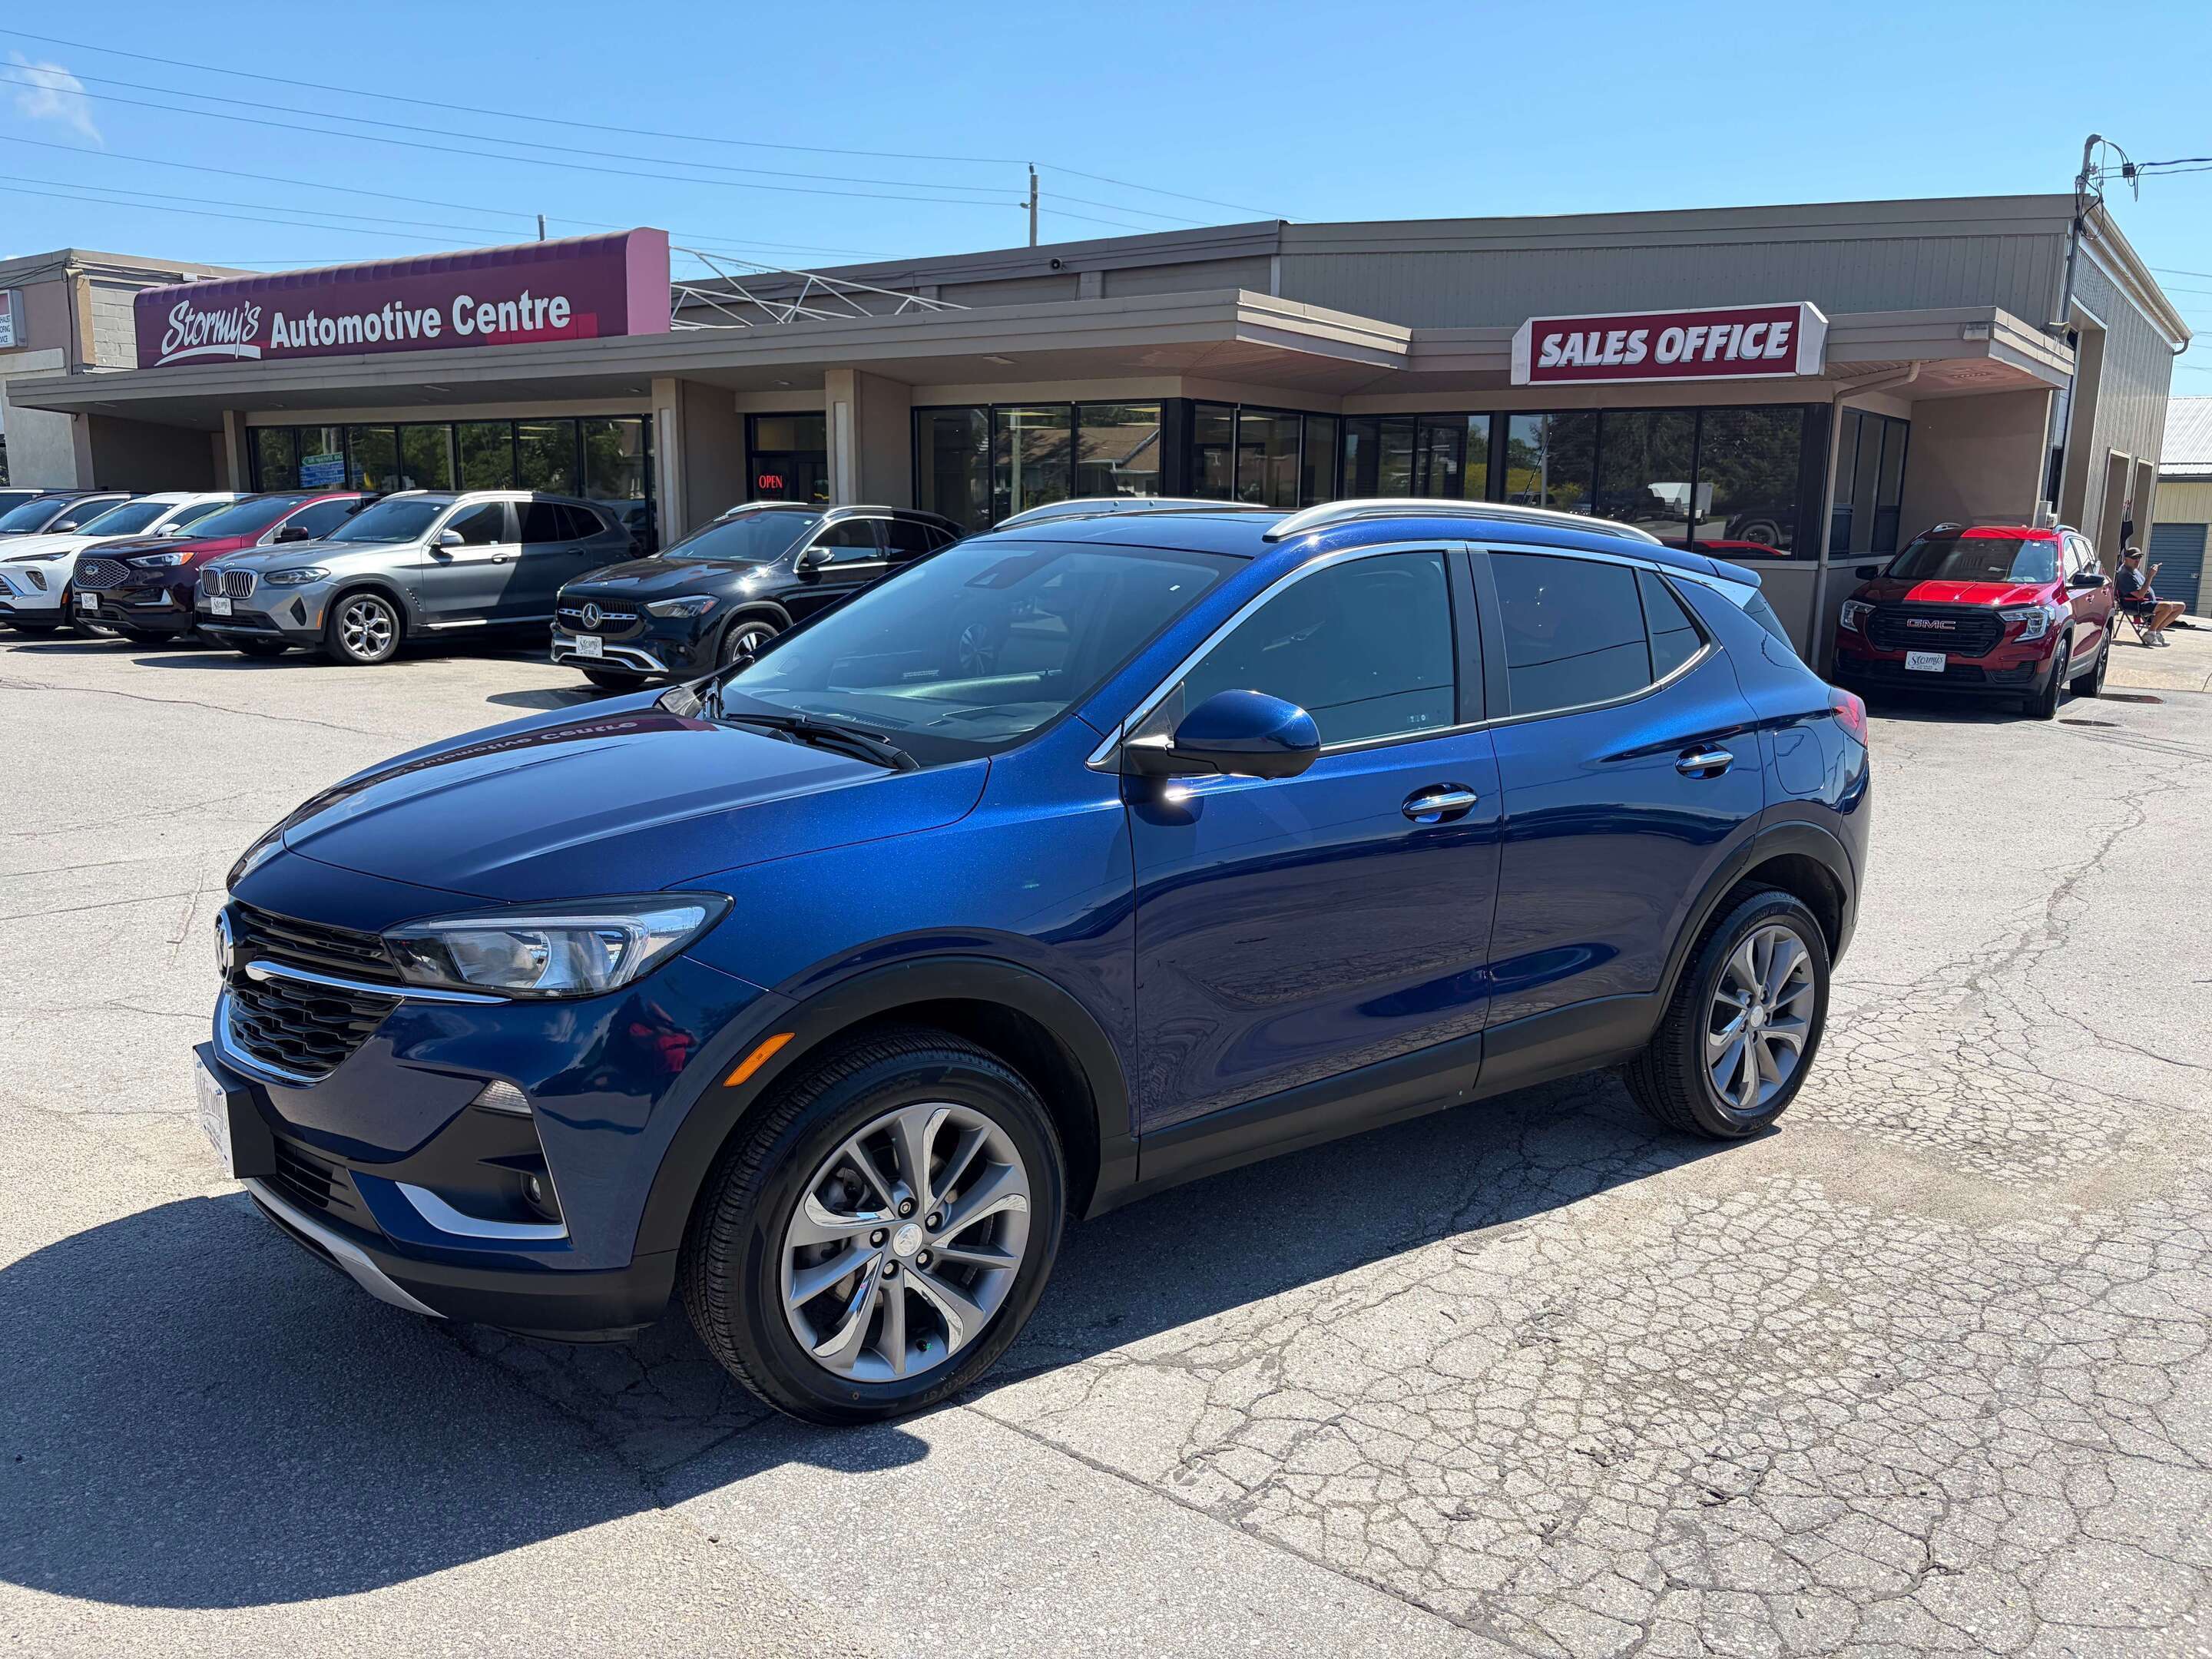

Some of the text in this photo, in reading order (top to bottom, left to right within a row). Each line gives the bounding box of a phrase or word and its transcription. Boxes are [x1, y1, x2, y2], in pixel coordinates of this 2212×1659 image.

[162, 290, 571, 359] Stormy's Automotive Centre
[1538, 321, 1793, 367] SALES OFFICE
[759, 475, 783, 488] OPEN
[1907, 618, 1955, 629] GMC
